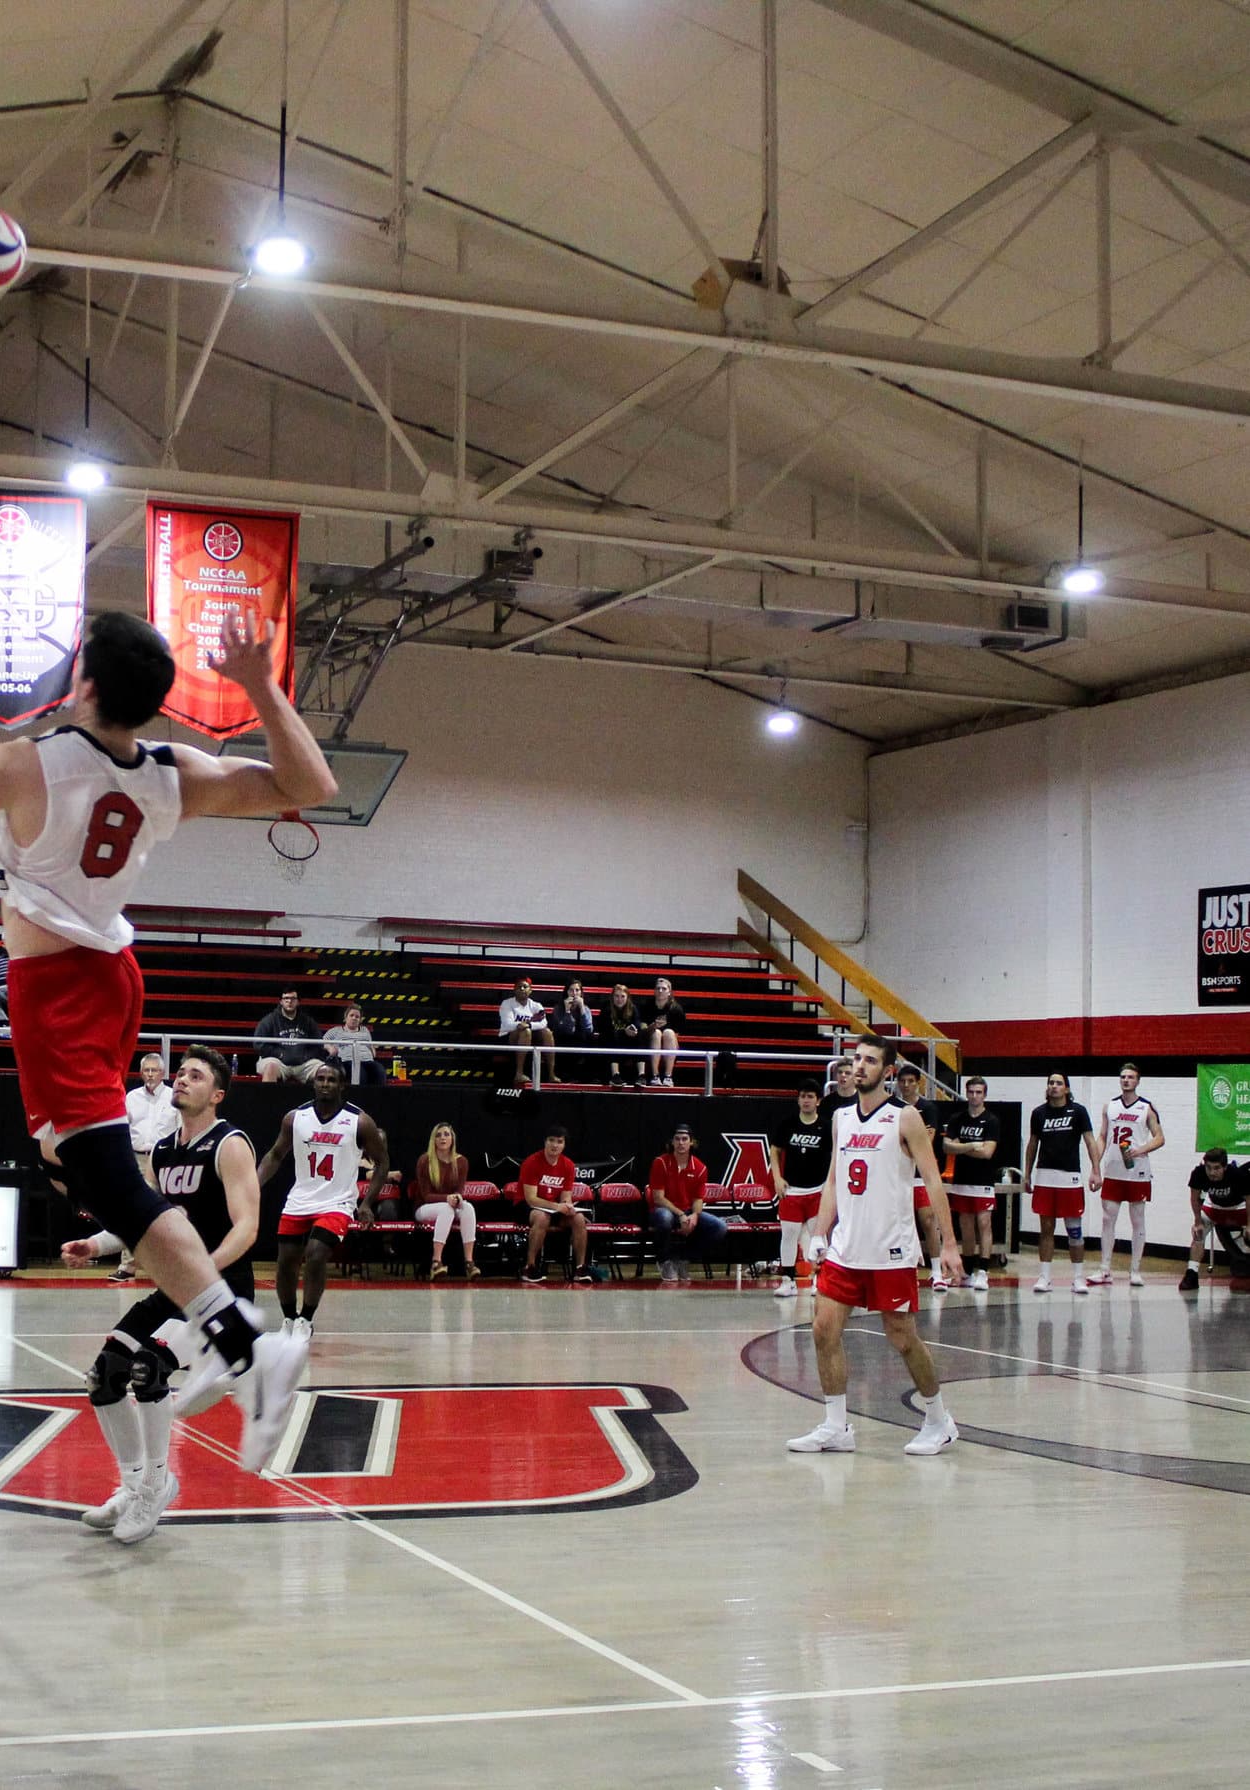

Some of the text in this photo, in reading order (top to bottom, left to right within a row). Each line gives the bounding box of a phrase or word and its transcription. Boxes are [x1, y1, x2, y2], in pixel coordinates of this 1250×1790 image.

[199, 567, 246, 580] NCCAA
[183, 579, 263, 596] Tournament
[79, 791, 145, 879] 8
[1202, 893, 1250, 929] JUST
[1043, 1116, 1073, 1129] NGU
[311, 1131, 344, 1145] NGU
[790, 1133, 822, 1145] NGU
[960, 1125, 985, 1138] NGU
[1113, 1126, 1134, 1146] 12
[846, 1133, 885, 1149] NGU
[307, 1152, 335, 1181] 14
[159, 1165, 204, 1195] NGU
[539, 1174, 566, 1186] NGU
[848, 1159, 869, 1195] 9
